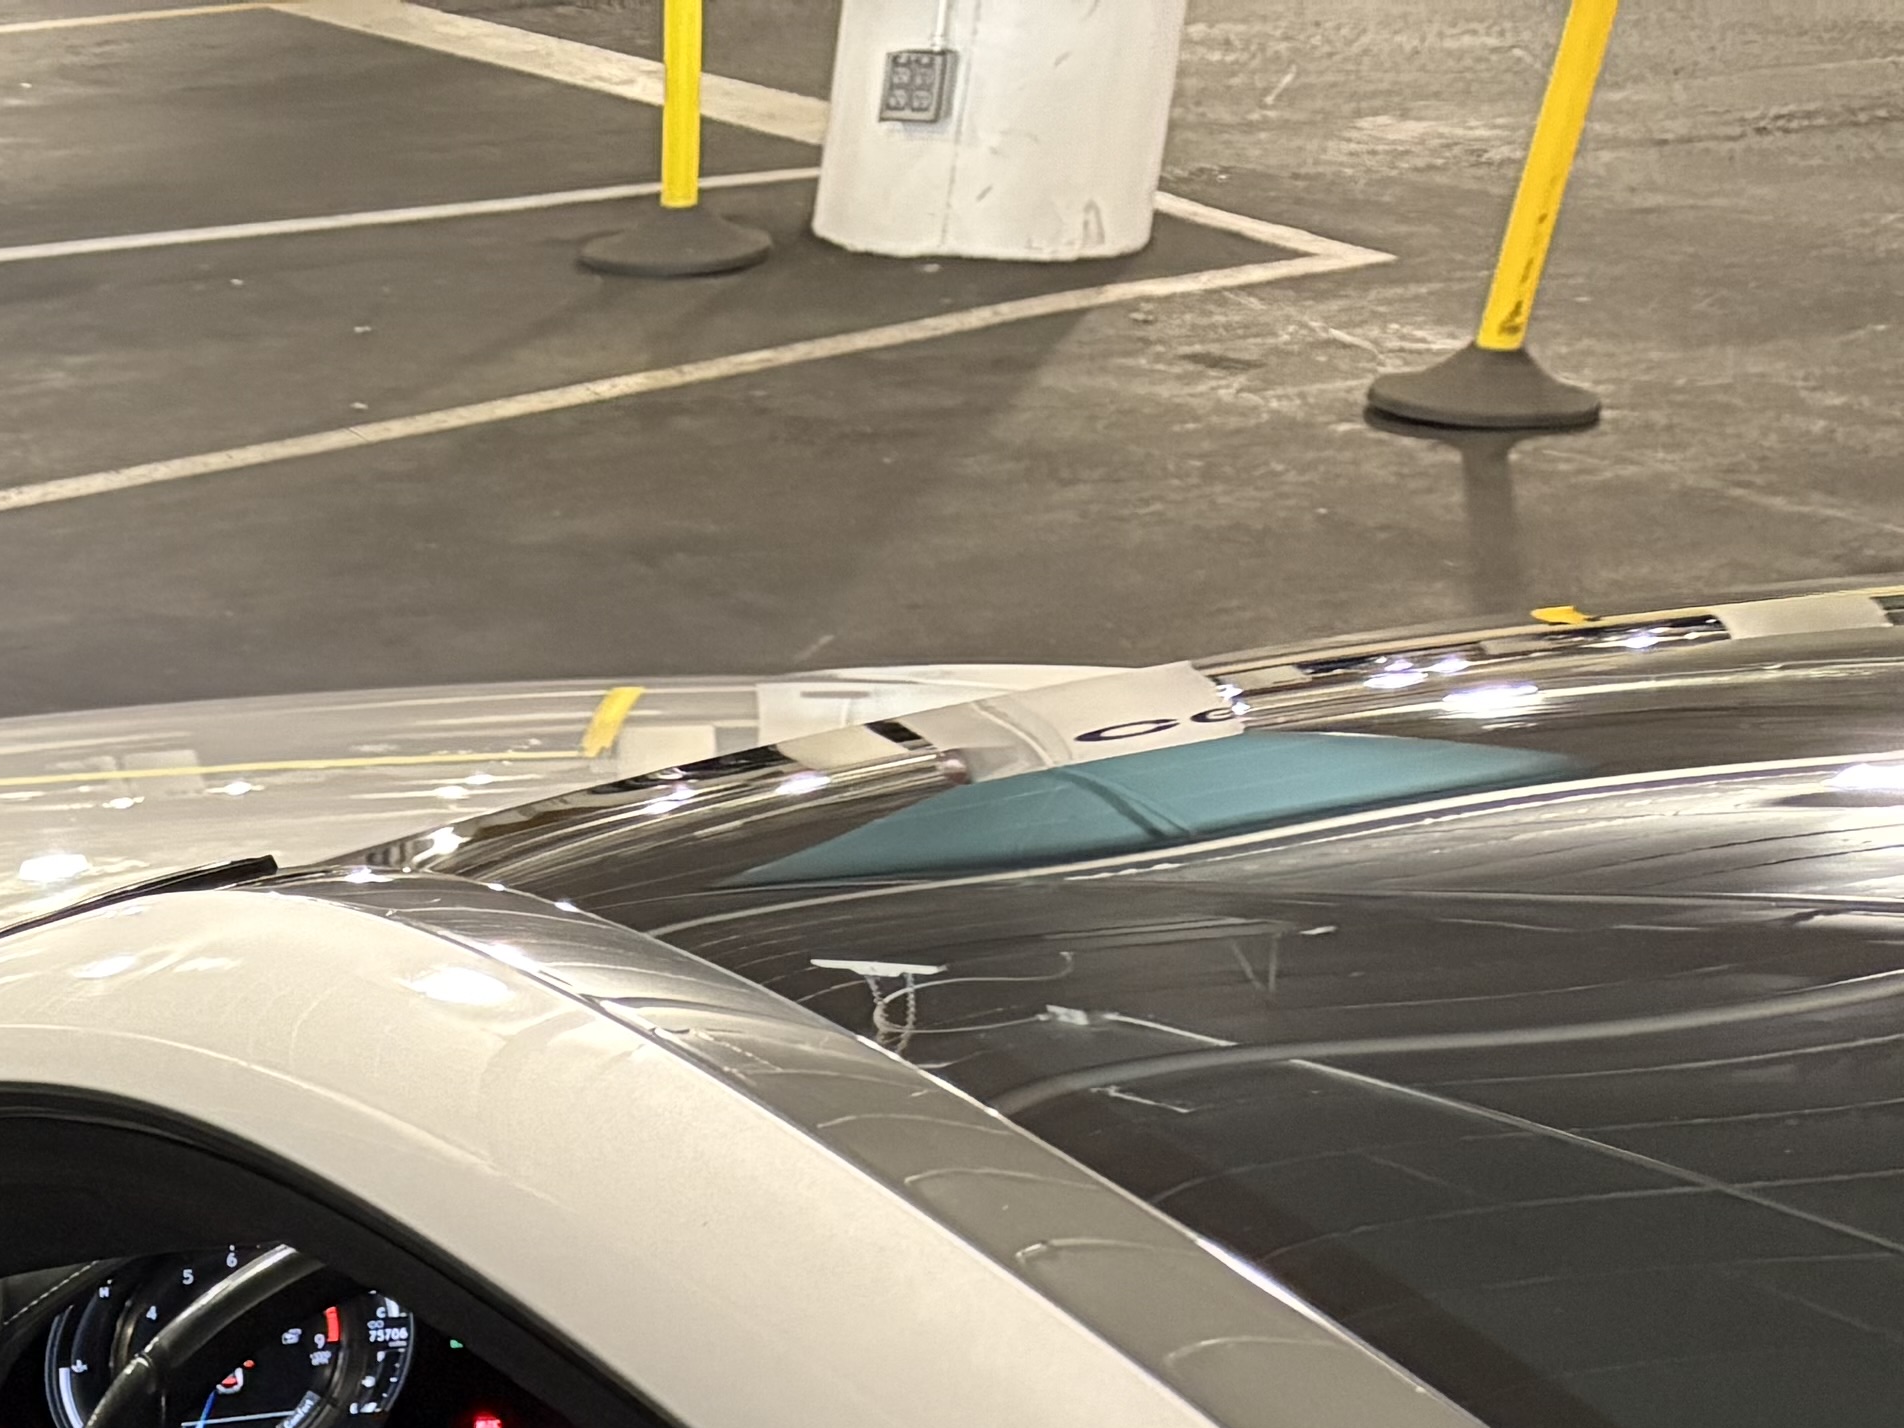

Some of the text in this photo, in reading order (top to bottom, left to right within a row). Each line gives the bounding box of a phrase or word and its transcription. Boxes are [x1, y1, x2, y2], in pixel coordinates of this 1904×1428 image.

[226, 1252, 238, 1268] 6
[182, 1269, 194, 1285] 5
[146, 1305, 158, 1321] 4
[314, 1332, 326, 1350] 9
